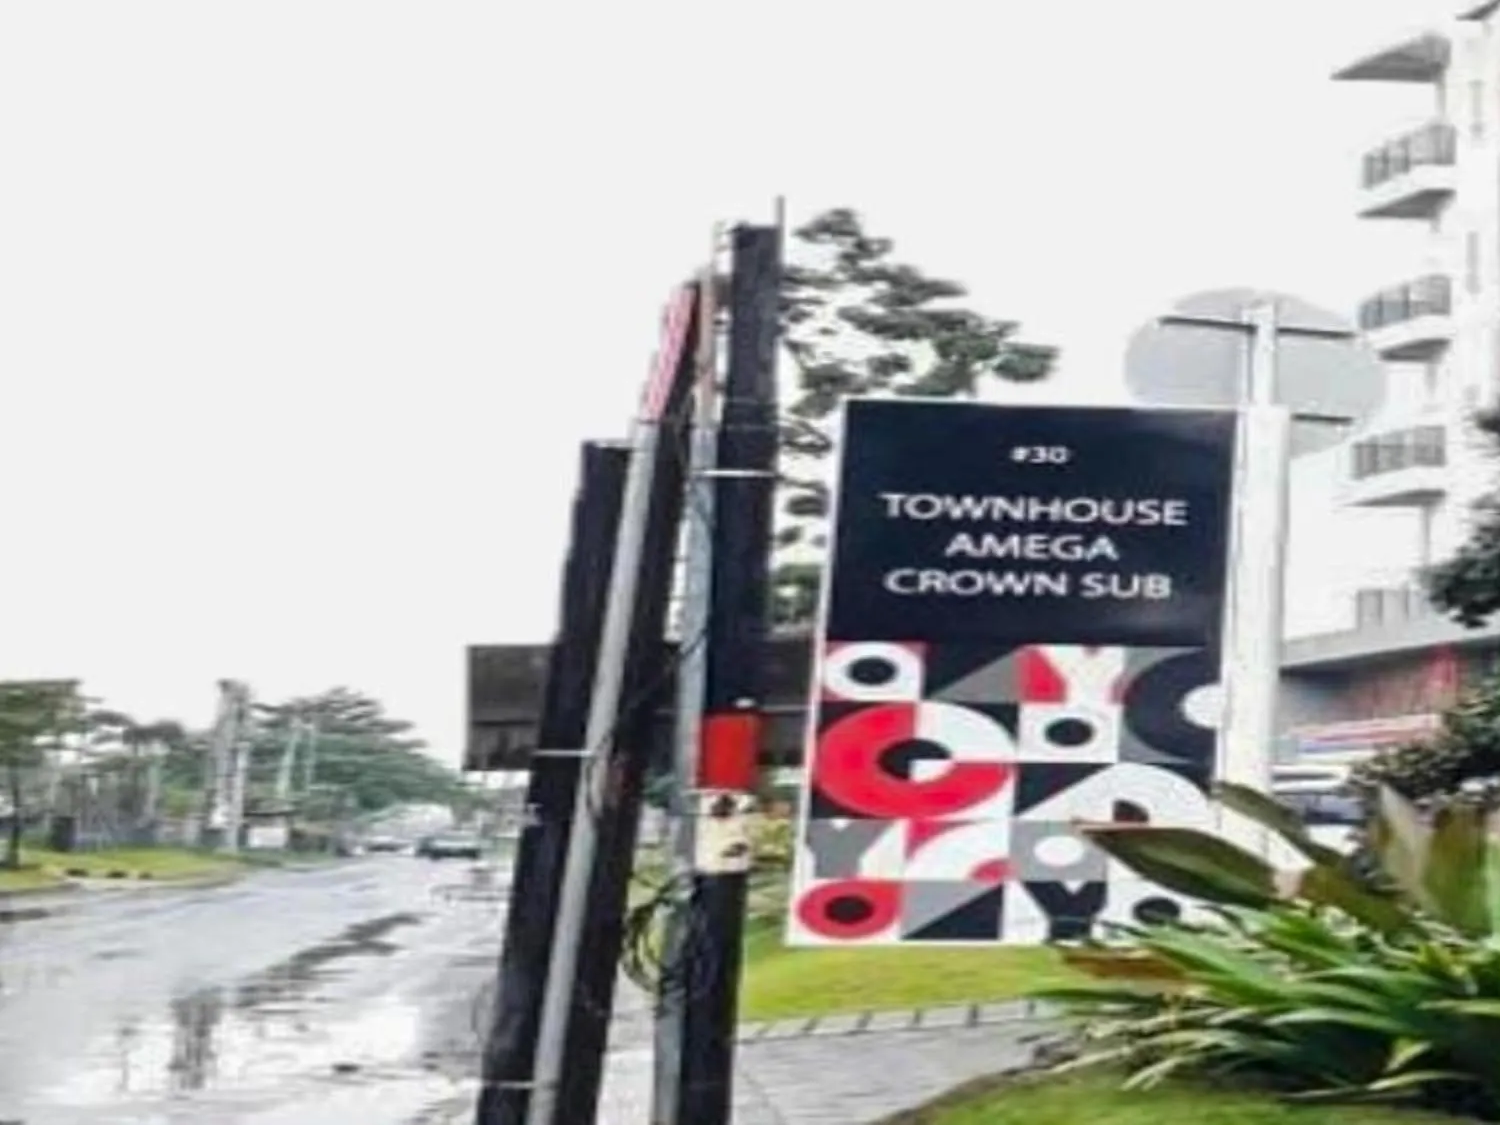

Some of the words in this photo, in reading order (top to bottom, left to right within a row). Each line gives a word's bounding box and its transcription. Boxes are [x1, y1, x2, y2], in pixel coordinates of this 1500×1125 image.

[1010, 445, 1071, 464] #30
[878, 491, 1190, 526] TOWNHOUSE
[944, 532, 1120, 562] AMEGA
[883, 568, 1069, 597] CROWN
[1079, 574, 1174, 599] SUB
